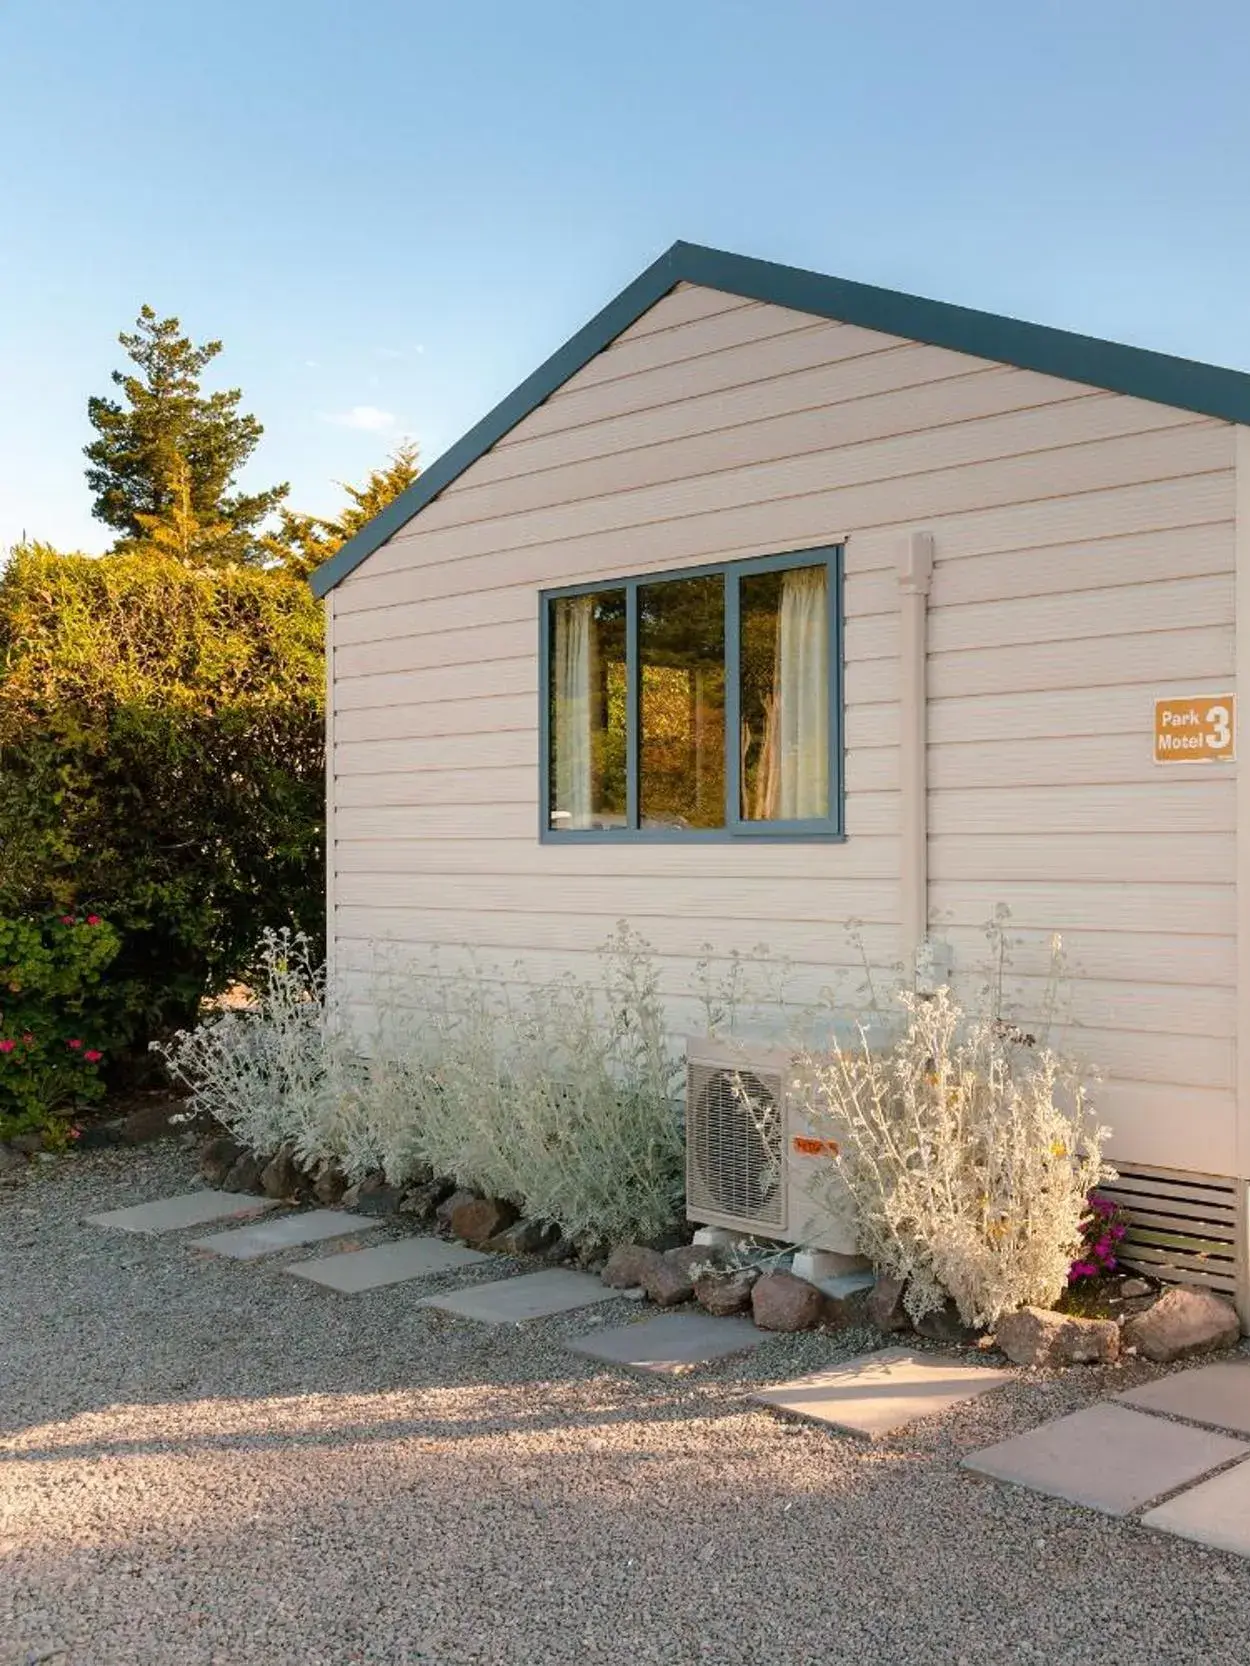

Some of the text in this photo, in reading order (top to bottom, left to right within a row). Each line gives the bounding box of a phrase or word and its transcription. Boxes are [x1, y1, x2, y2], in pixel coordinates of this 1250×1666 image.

[1162, 709, 1200, 727] Park
[1206, 706, 1231, 748] 3
[1159, 732, 1203, 750] Motel
